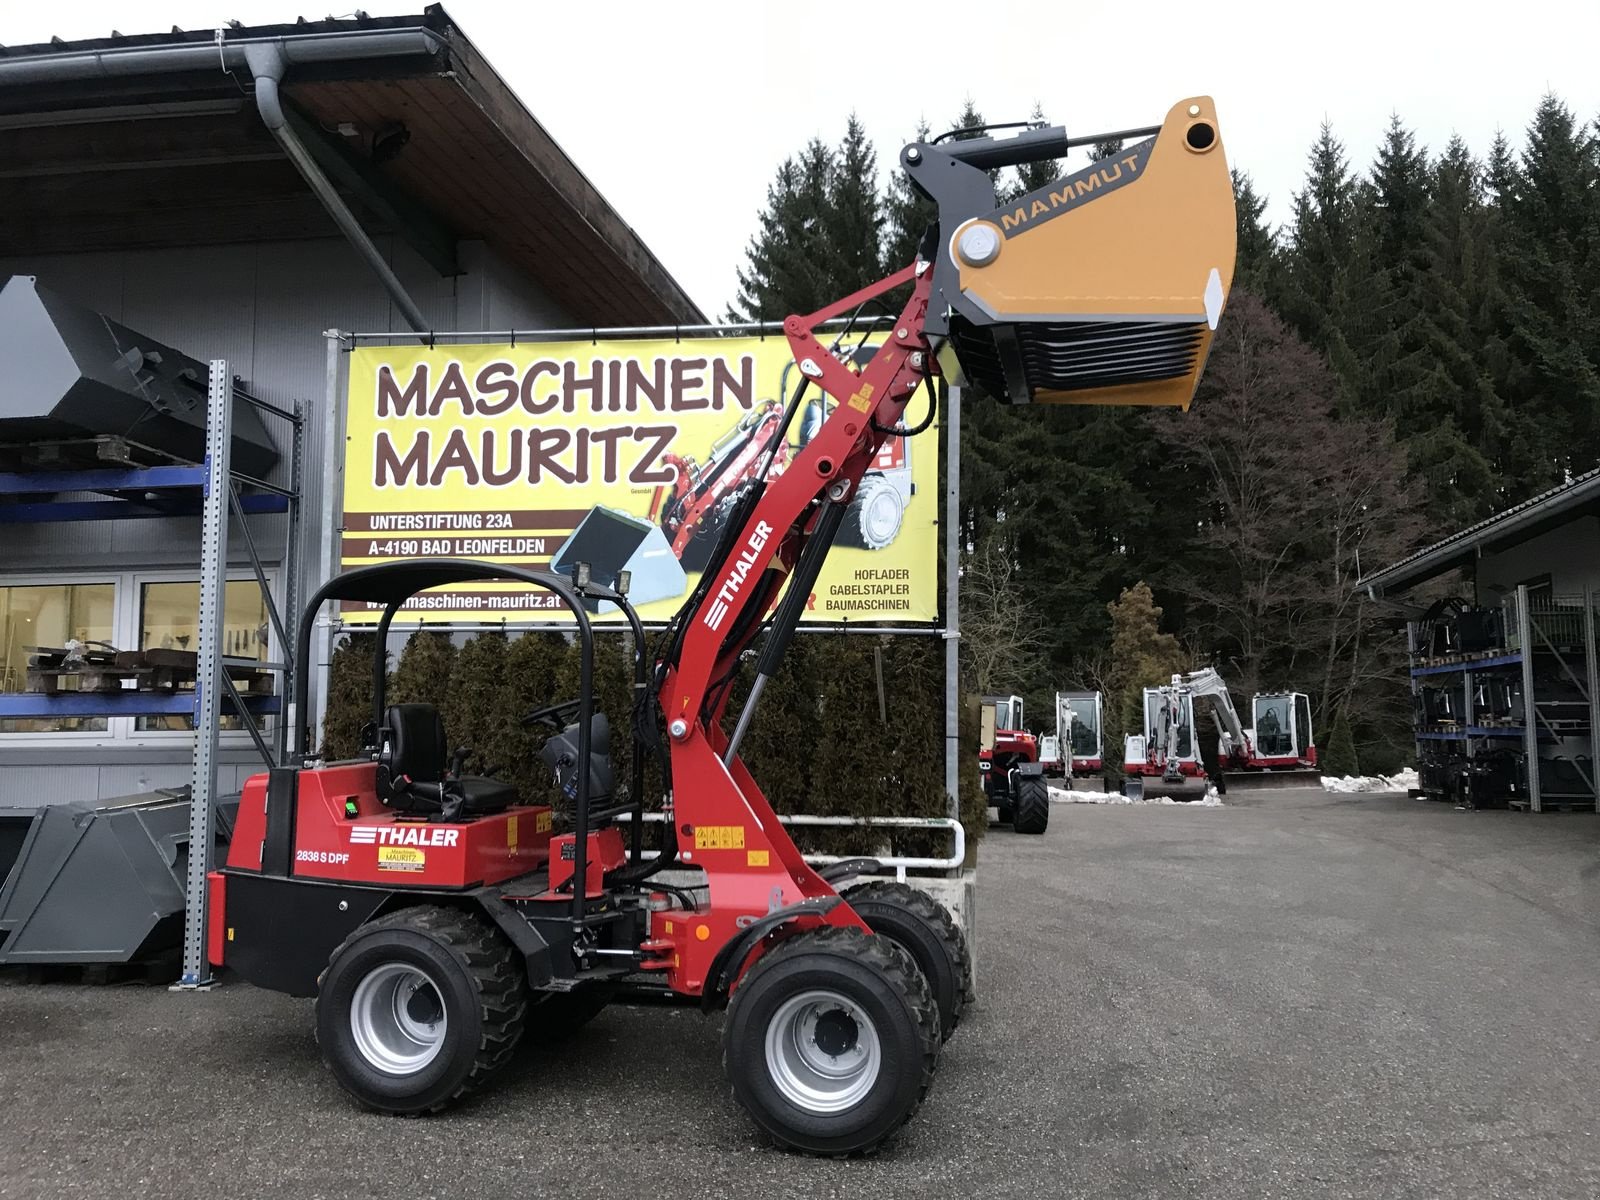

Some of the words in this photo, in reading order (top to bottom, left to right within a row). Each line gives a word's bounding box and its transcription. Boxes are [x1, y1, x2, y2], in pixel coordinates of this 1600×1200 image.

[1001, 154, 1138, 230] MAMMUT
[376, 356, 753, 417] MASCHINEN
[374, 426, 677, 487] MAURITZ
[370, 514, 482, 530] UNTERSTIFTUNG
[485, 513, 513, 529] 23A
[368, 540, 418, 555] A-4190
[421, 540, 451, 555] BAD
[455, 539, 545, 554] LEONFELDEN
[718, 520, 774, 602] THALER
[854, 569, 909, 580] HOFLADER
[829, 584, 910, 596] GABELSTAPLER
[366, 594, 562, 609] w.maschinen-mauritz.at
[825, 599, 910, 611] BAUMASCHINEN
[377, 827, 459, 847] THALER
[296, 850, 319, 863] 2838
[320, 852, 327, 864] S
[328, 852, 350, 865] DPF
[386, 853, 418, 863] MAURITZ
